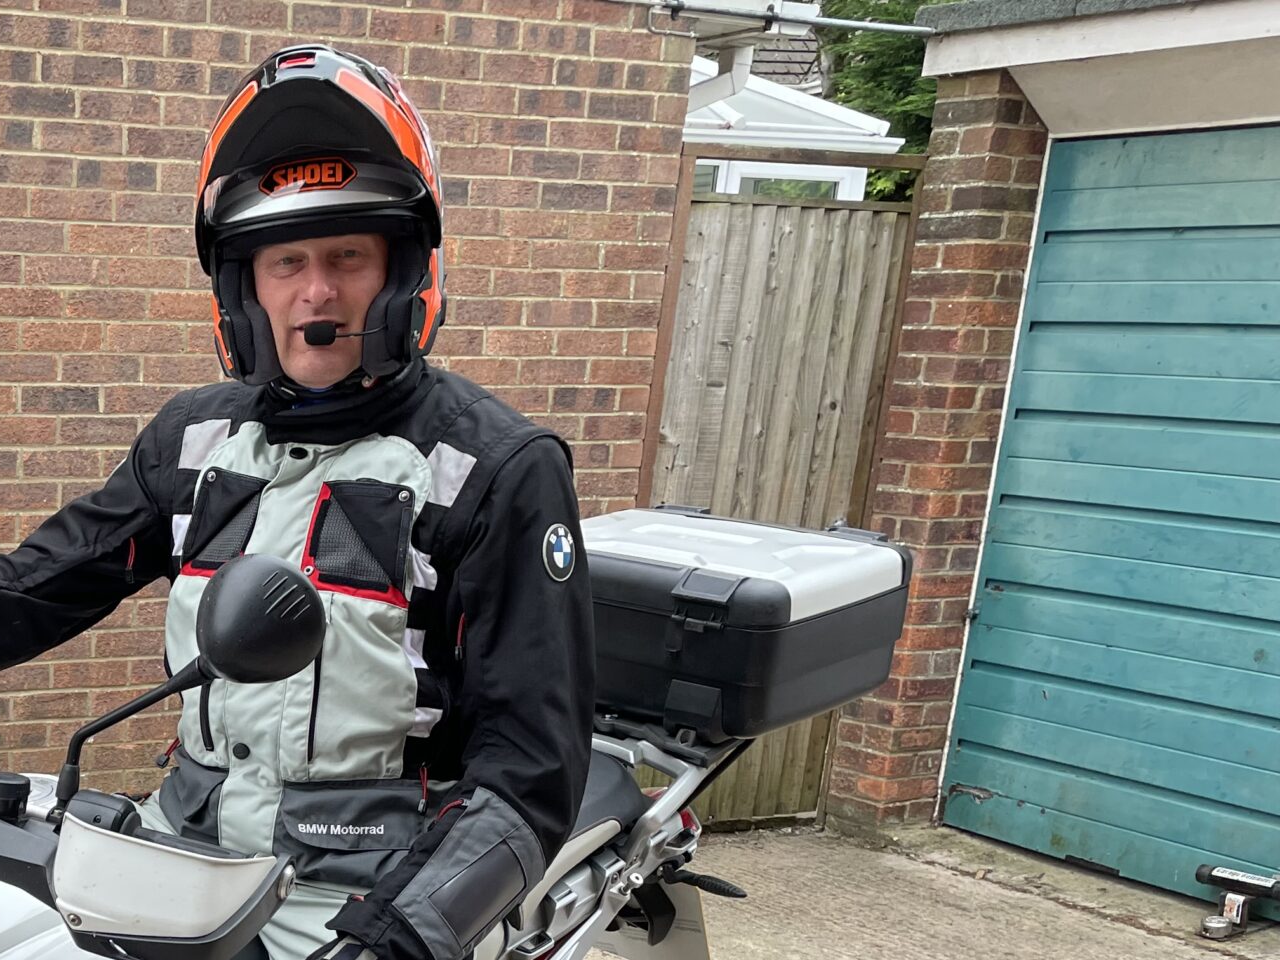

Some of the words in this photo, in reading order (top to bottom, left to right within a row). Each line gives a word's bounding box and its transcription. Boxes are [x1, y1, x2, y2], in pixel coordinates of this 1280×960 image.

[273, 163, 342, 190] SHOEI
[549, 527, 573, 545] BMW
[298, 824, 328, 834] BMW
[330, 825, 384, 835] Motorrad
